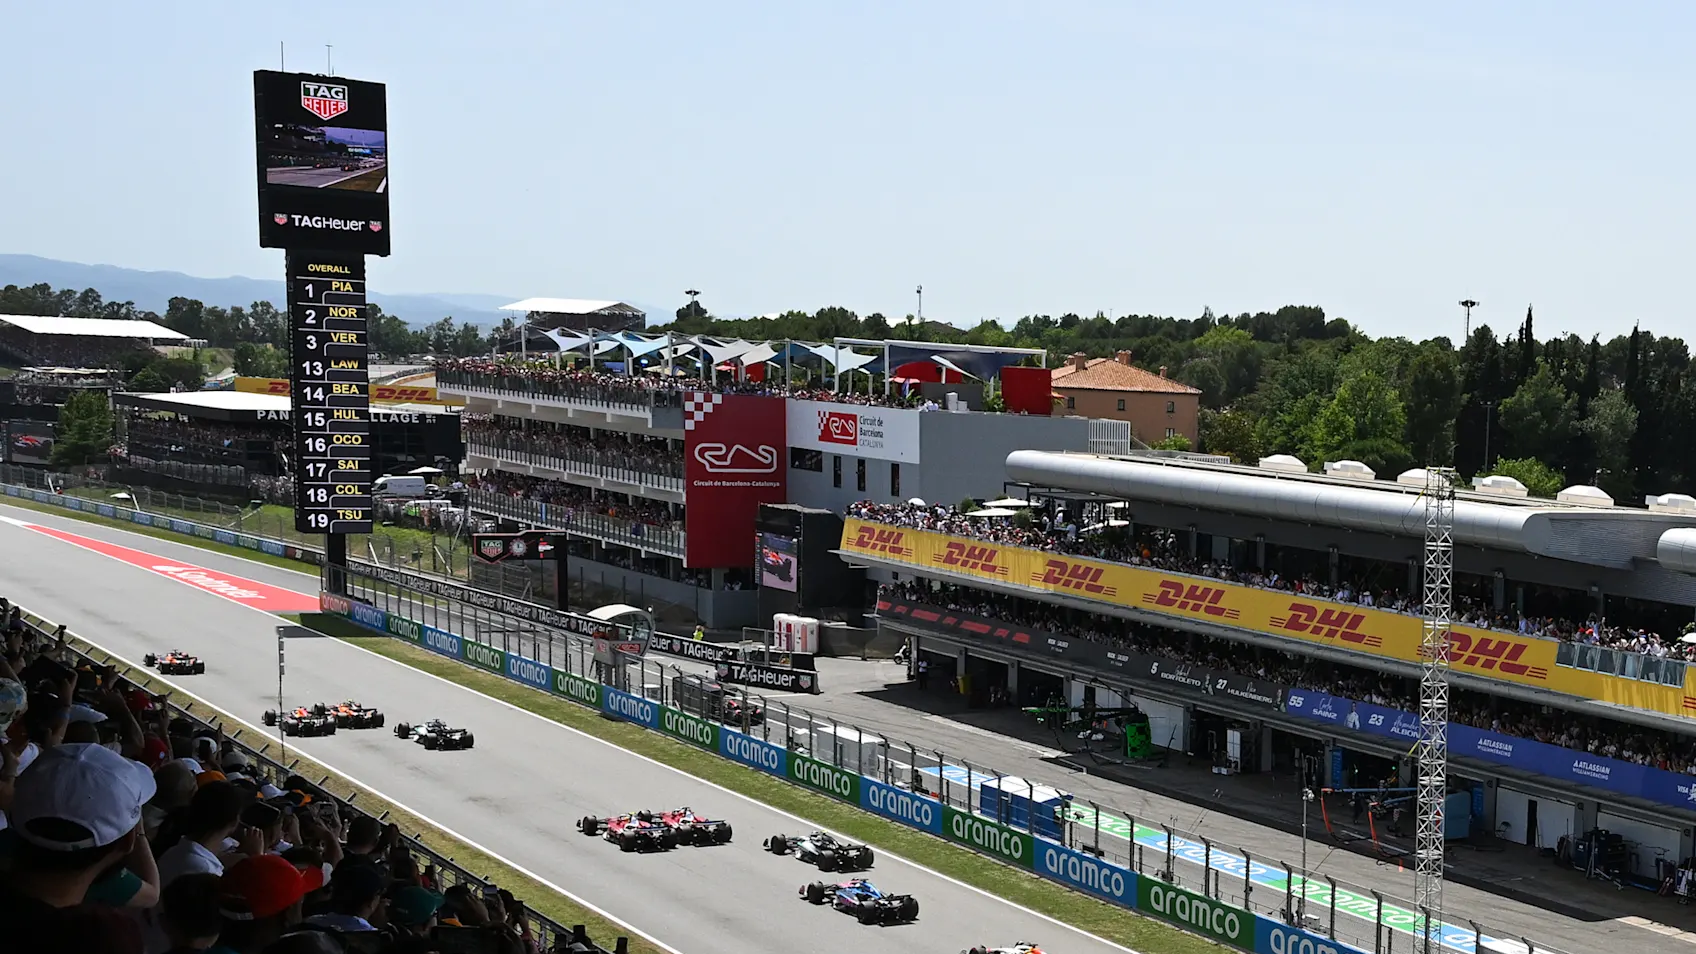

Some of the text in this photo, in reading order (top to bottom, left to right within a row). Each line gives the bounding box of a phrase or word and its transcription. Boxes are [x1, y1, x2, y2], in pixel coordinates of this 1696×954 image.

[305, 84, 344, 100] TAG
[304, 98, 347, 118] HEUER
[308, 264, 351, 274] OVERALL
[305, 281, 353, 298] 1 PIA
[305, 307, 357, 324] 2 NOR
[306, 333, 357, 350] 3 VER
[302, 360, 358, 376] 13 LAW
[303, 387, 324, 401] 14
[332, 384, 359, 394] BEA
[376, 388, 431, 400] DHL
[257, 410, 289, 420] PAN
[371, 412, 419, 423] LLAGE
[304, 410, 360, 426] 15 HUL
[860, 416, 884, 428] Circuit de
[860, 427, 884, 438] Barcelona
[304, 434, 362, 452] 16 OCO
[306, 460, 358, 478] 17 SAI
[306, 485, 362, 502] 18 COL
[308, 510, 362, 528] 19 TSU
[854, 526, 904, 555] DHL
[942, 542, 998, 573] DHL
[1042, 560, 1106, 594] DHL
[322, 595, 348, 615] aramco
[1154, 580, 1228, 617] DHL
[354, 608, 382, 628] aramco
[1284, 602, 1366, 644] DHL
[390, 618, 418, 640] aramco
[426, 630, 458, 654] aramco
[651, 638, 671, 650] euer
[467, 644, 500, 668] aramco
[683, 643, 724, 661] TAGHeue
[1439, 630, 1530, 676] DHL
[510, 660, 546, 686] aramco
[1150, 662, 1158, 674] 5
[557, 674, 597, 703] aramco
[1161, 672, 1201, 687] BORTOLETO
[1216, 678, 1228, 690] 27
[609, 692, 652, 722] aramco
[1288, 696, 1304, 708] 55
[1312, 708, 1338, 720] SAINZ
[1368, 714, 1384, 726] 23
[665, 711, 712, 745] aramco
[1390, 726, 1420, 739] ALBON
[726, 734, 778, 769] aramco
[1483, 739, 1513, 752] ATLASSIAN
[1578, 761, 1611, 774] ATLASSIAN
[794, 758, 851, 796] aramco
[869, 785, 932, 826] aramco
[952, 814, 1022, 859] aramco
[1156, 836, 1268, 876] aramco
[1046, 848, 1124, 897] aramco
[1150, 885, 1240, 939] aramco
[1290, 882, 1414, 924] aramco
